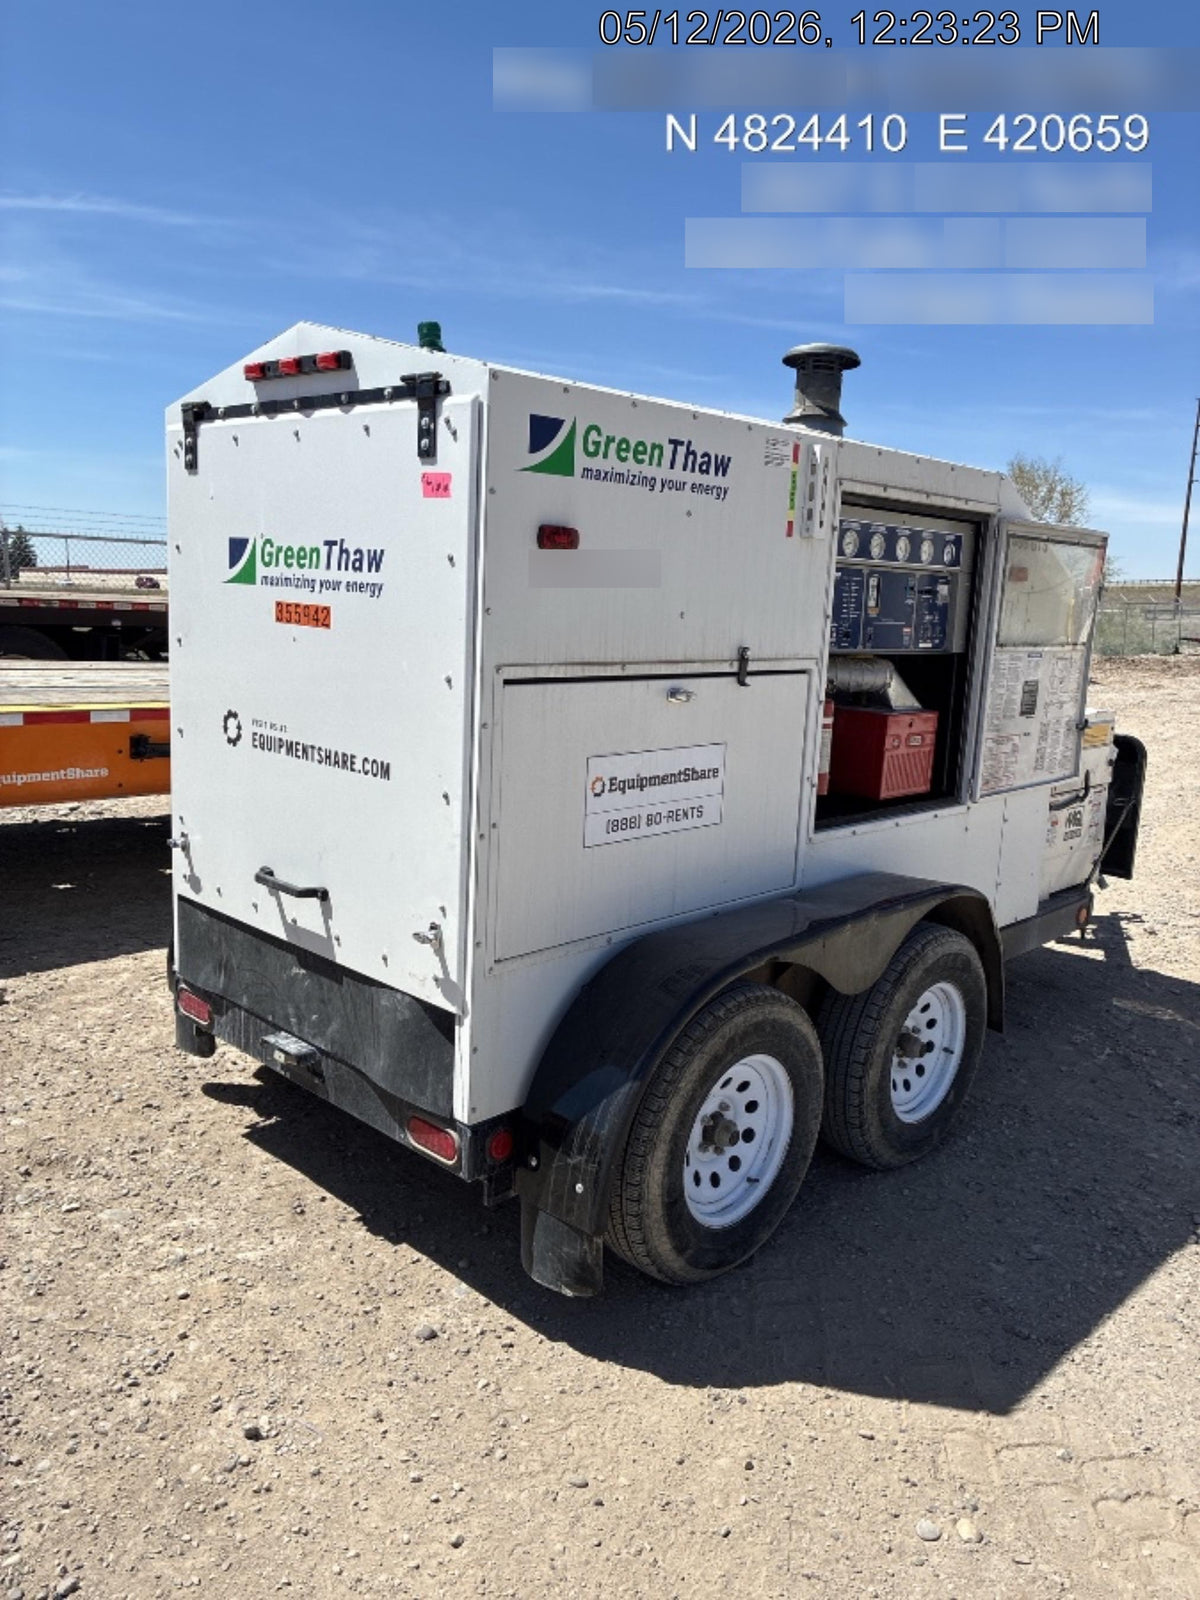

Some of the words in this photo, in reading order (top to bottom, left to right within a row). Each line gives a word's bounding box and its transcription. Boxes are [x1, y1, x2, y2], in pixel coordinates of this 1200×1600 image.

[581, 466, 656, 492] maximizing
[659, 477, 687, 493] your
[690, 481, 730, 501] energy
[260, 572, 317, 593] maximizing
[319, 577, 342, 594] your
[345, 580, 384, 598] energy
[275, 601, 331, 628] 355942
[251, 732, 391, 781] EQUIPMENTSHARE.COM
[0, 767, 109, 786] uipmentShare
[608, 767, 719, 794] EquipmentShare
